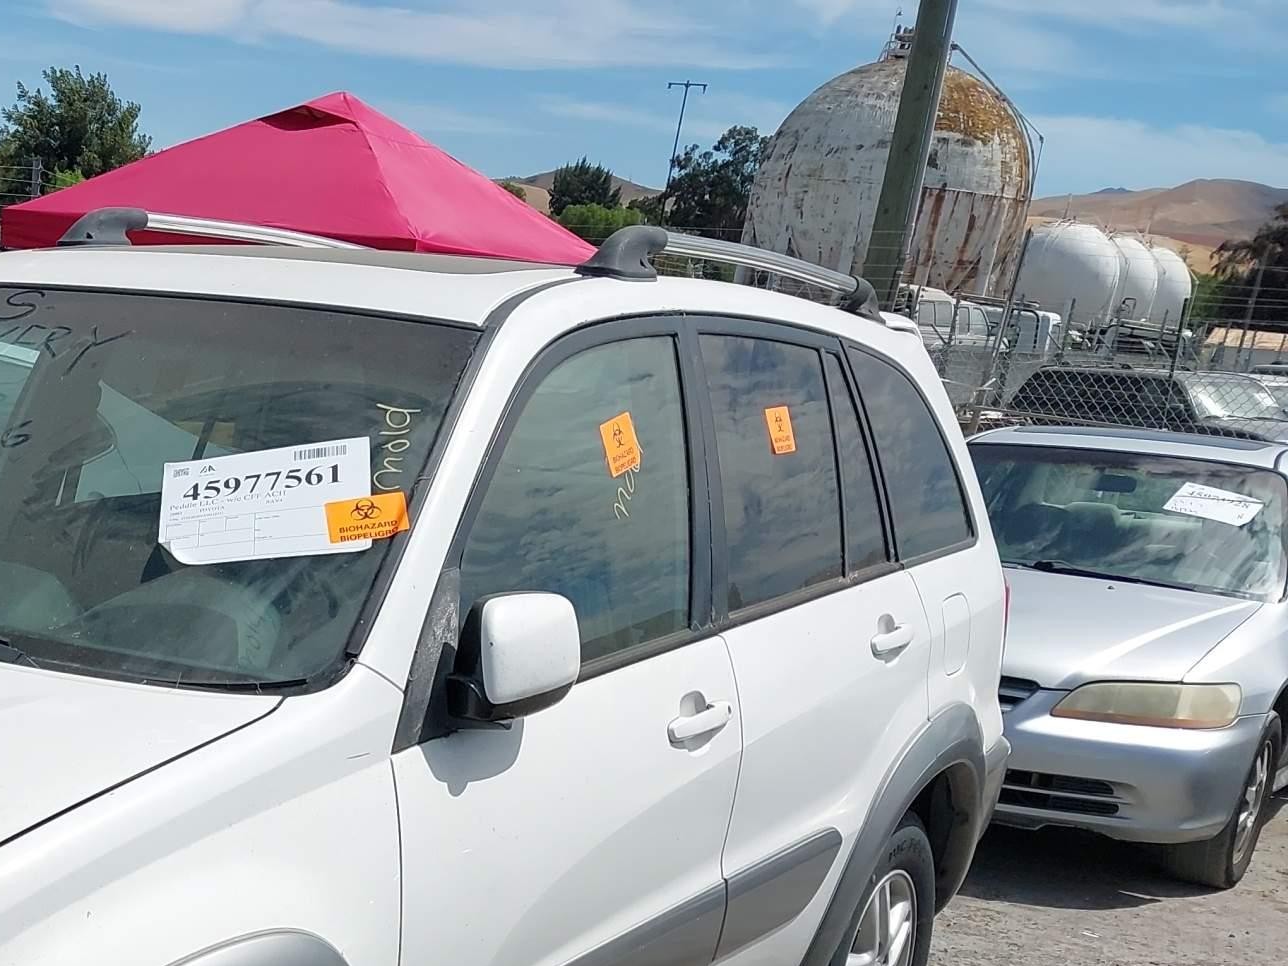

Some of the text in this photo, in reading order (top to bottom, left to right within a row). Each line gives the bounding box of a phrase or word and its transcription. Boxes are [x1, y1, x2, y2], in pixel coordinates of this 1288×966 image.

[182, 463, 344, 501] 45977561
[338, 520, 398, 534] BIOHAZARD
[340, 526, 399, 542] BIOPELIGRO
